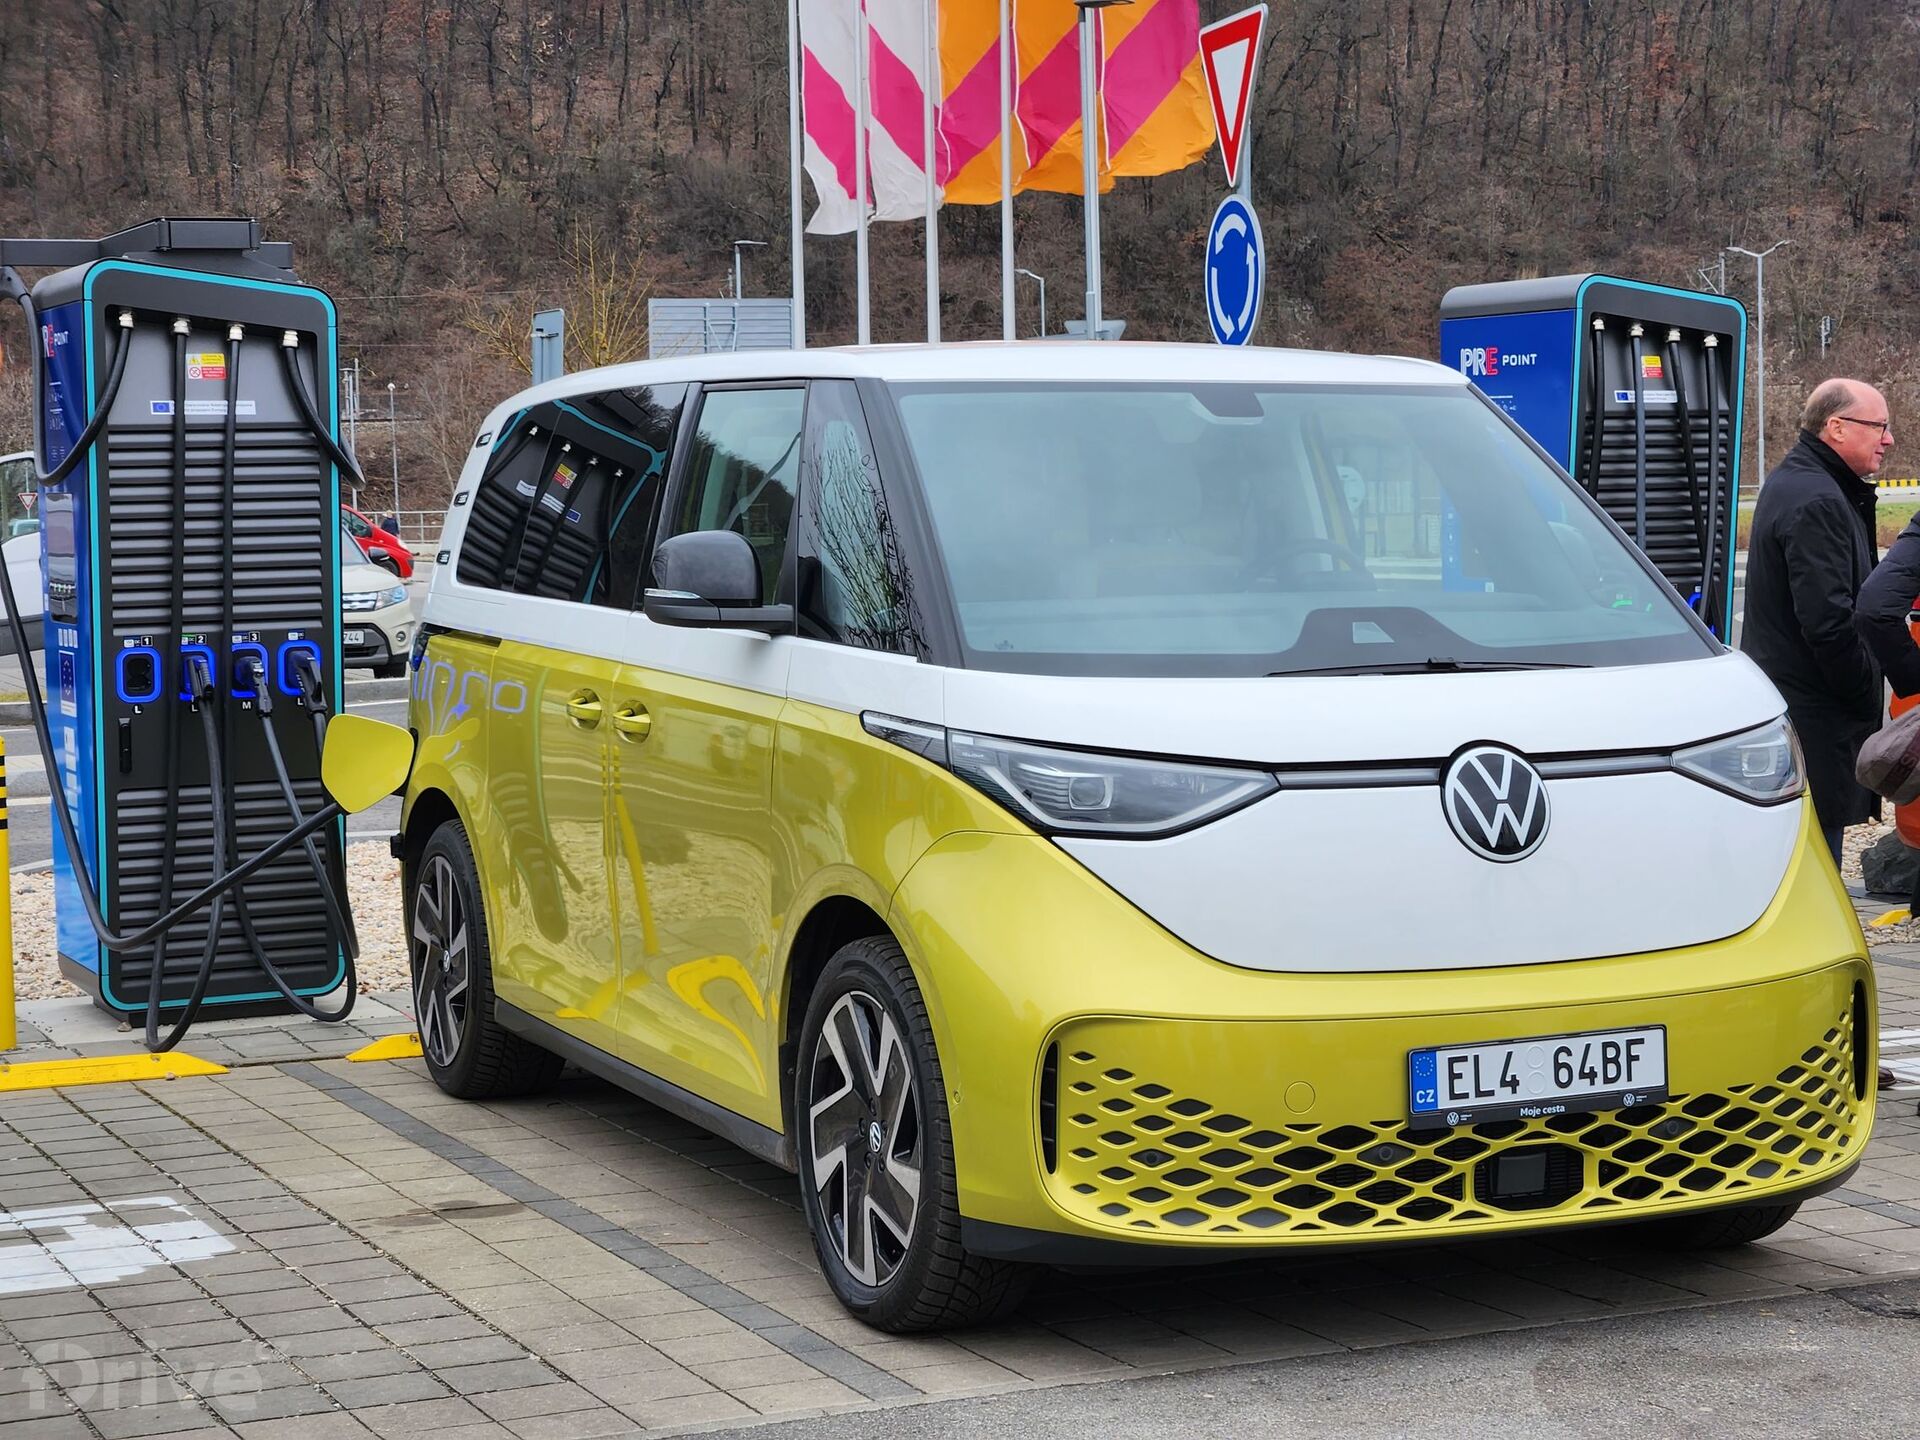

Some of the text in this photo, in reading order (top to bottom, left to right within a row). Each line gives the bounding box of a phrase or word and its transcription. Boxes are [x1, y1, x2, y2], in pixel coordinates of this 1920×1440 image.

[54, 331, 69, 346] POINT
[1460, 347, 1537, 376] PRE POINT
[143, 637, 149, 645] 1
[197, 635, 204, 643] 2
[251, 633, 258, 641] 3
[242, 701, 251, 710] M
[297, 698, 304, 706] L
[134, 705, 141, 714] L
[191, 704, 198, 712] L
[1445, 746, 1551, 863] VW
[1447, 1037, 1645, 1101] EL4 64BF
[1416, 1088, 1435, 1104] CZ
[1519, 1104, 1566, 1118] Moje cesta
